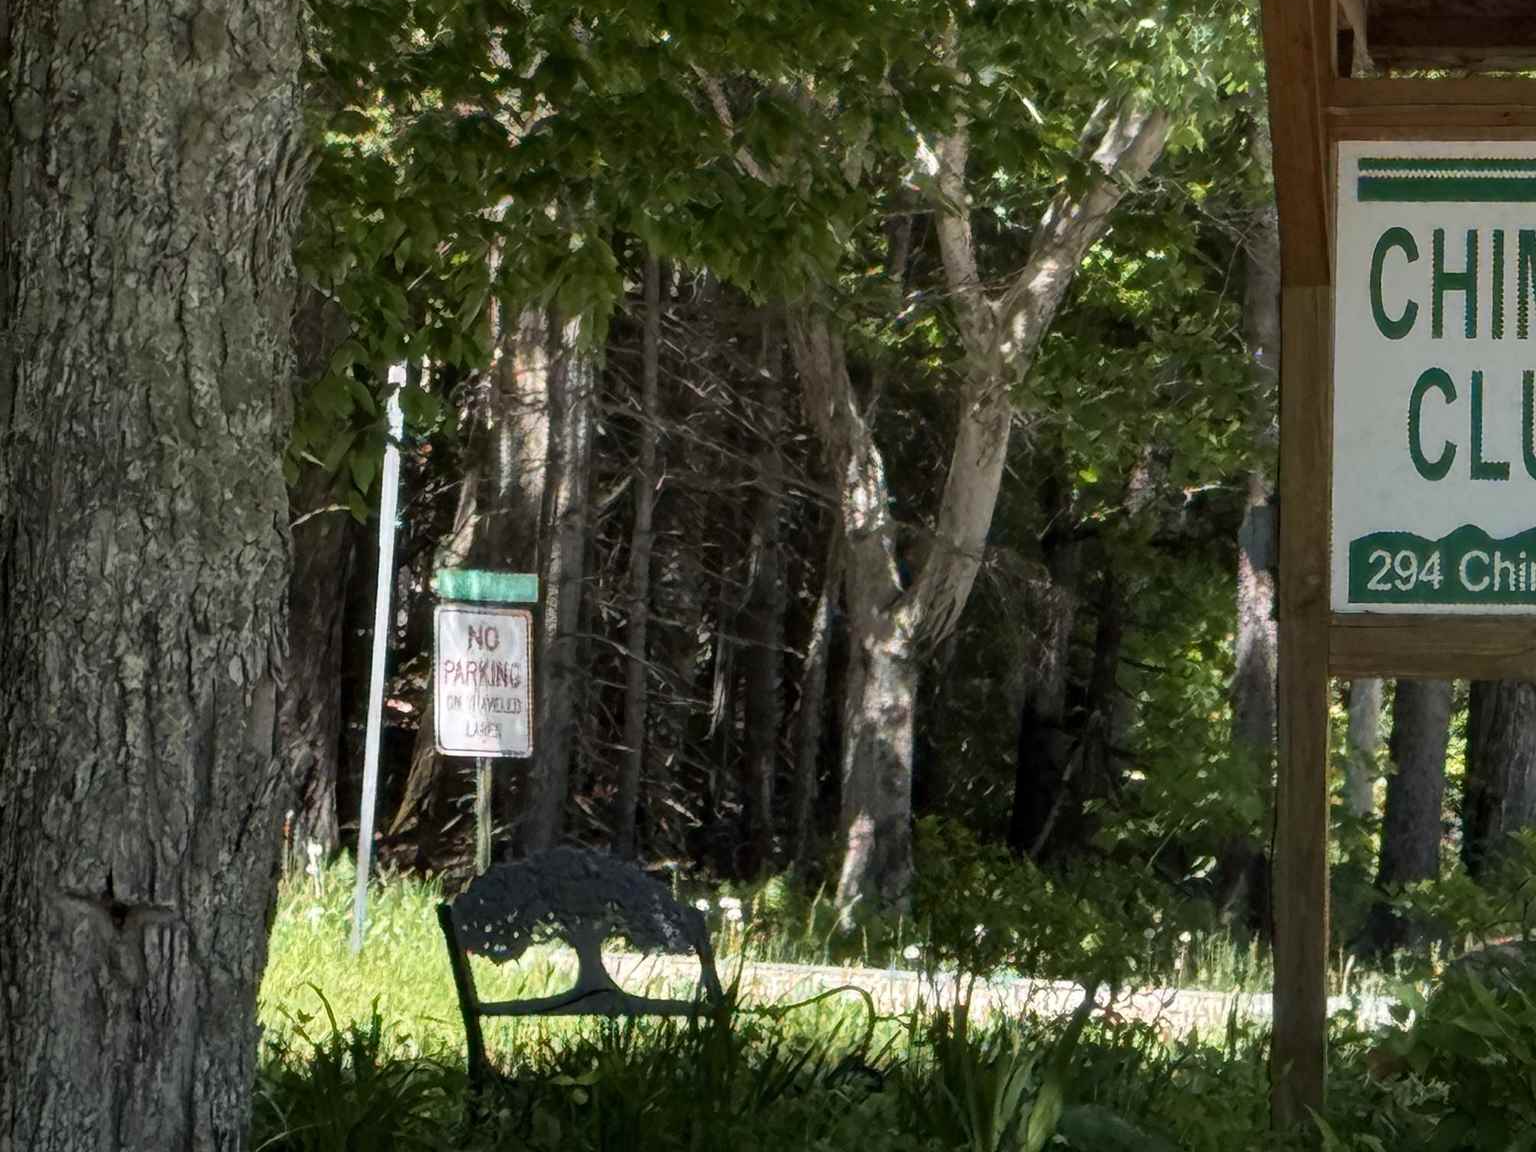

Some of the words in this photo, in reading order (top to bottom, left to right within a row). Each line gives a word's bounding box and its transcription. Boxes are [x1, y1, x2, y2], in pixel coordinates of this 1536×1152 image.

[1367, 550, 1443, 592] 294
[467, 625, 498, 650] NO
[443, 660, 521, 688] PARKING
